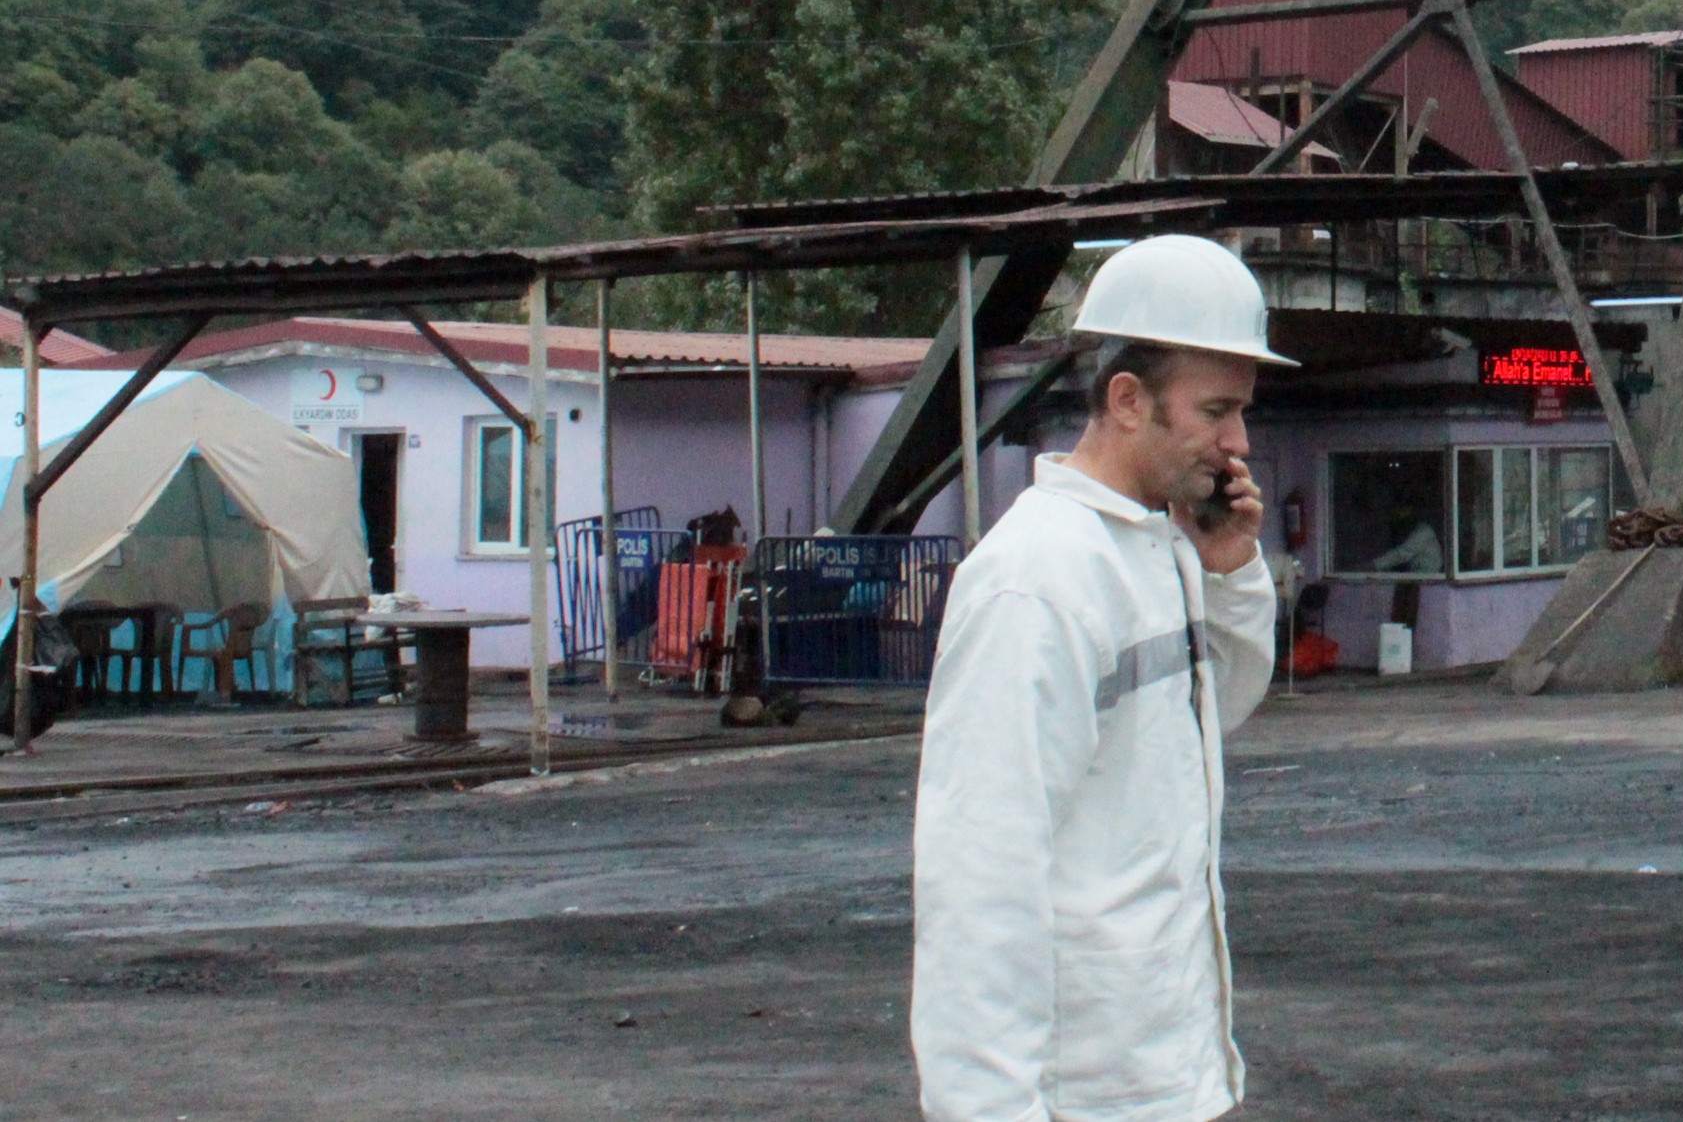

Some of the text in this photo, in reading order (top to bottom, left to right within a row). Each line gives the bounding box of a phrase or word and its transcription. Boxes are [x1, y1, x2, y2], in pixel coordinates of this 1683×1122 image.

[1494, 360, 1530, 379] Allah'a
[617, 534, 649, 555] POLİS
[816, 543, 860, 565] POLİS
